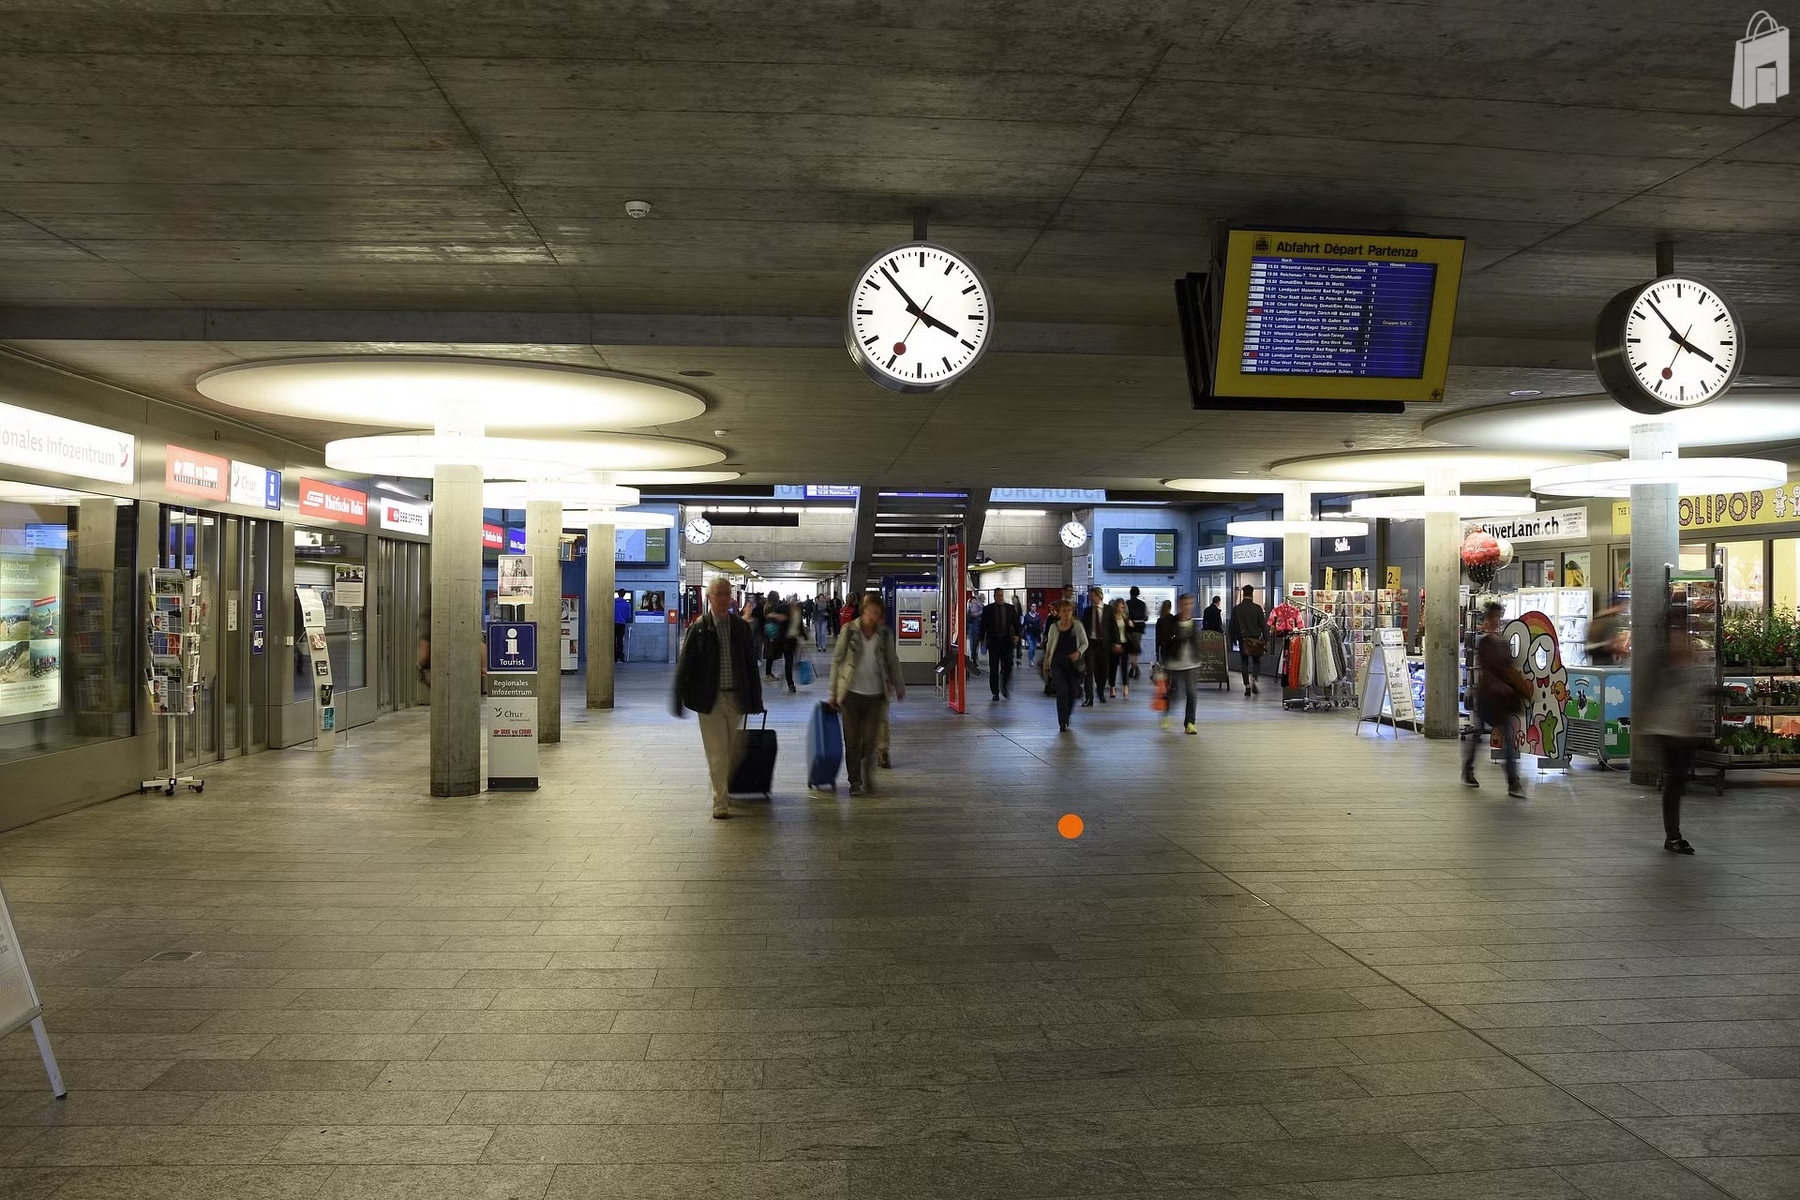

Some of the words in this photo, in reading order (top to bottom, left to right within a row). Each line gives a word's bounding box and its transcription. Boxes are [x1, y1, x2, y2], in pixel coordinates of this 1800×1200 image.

[1276, 241, 1320, 253] Abfahrt
[1324, 243, 1364, 257] Départ
[1368, 245, 1419, 257] Partenza
[47, 435, 115, 466] Infozentrum
[241, 475, 257, 491] Chur
[325, 493, 350, 513] Rhätische
[351, 500, 364, 516] Bahn
[1617, 507, 1627, 515] THE
[1482, 516, 1560, 540] SilverLand.ch
[1233, 548, 1257, 560] BREZELKÖNIG
[2, 561, 29, 574] Hausberg
[1387, 571, 1399, 585] 2.-
[499, 658, 525, 666] Tourist
[493, 680, 529, 688] Regionales
